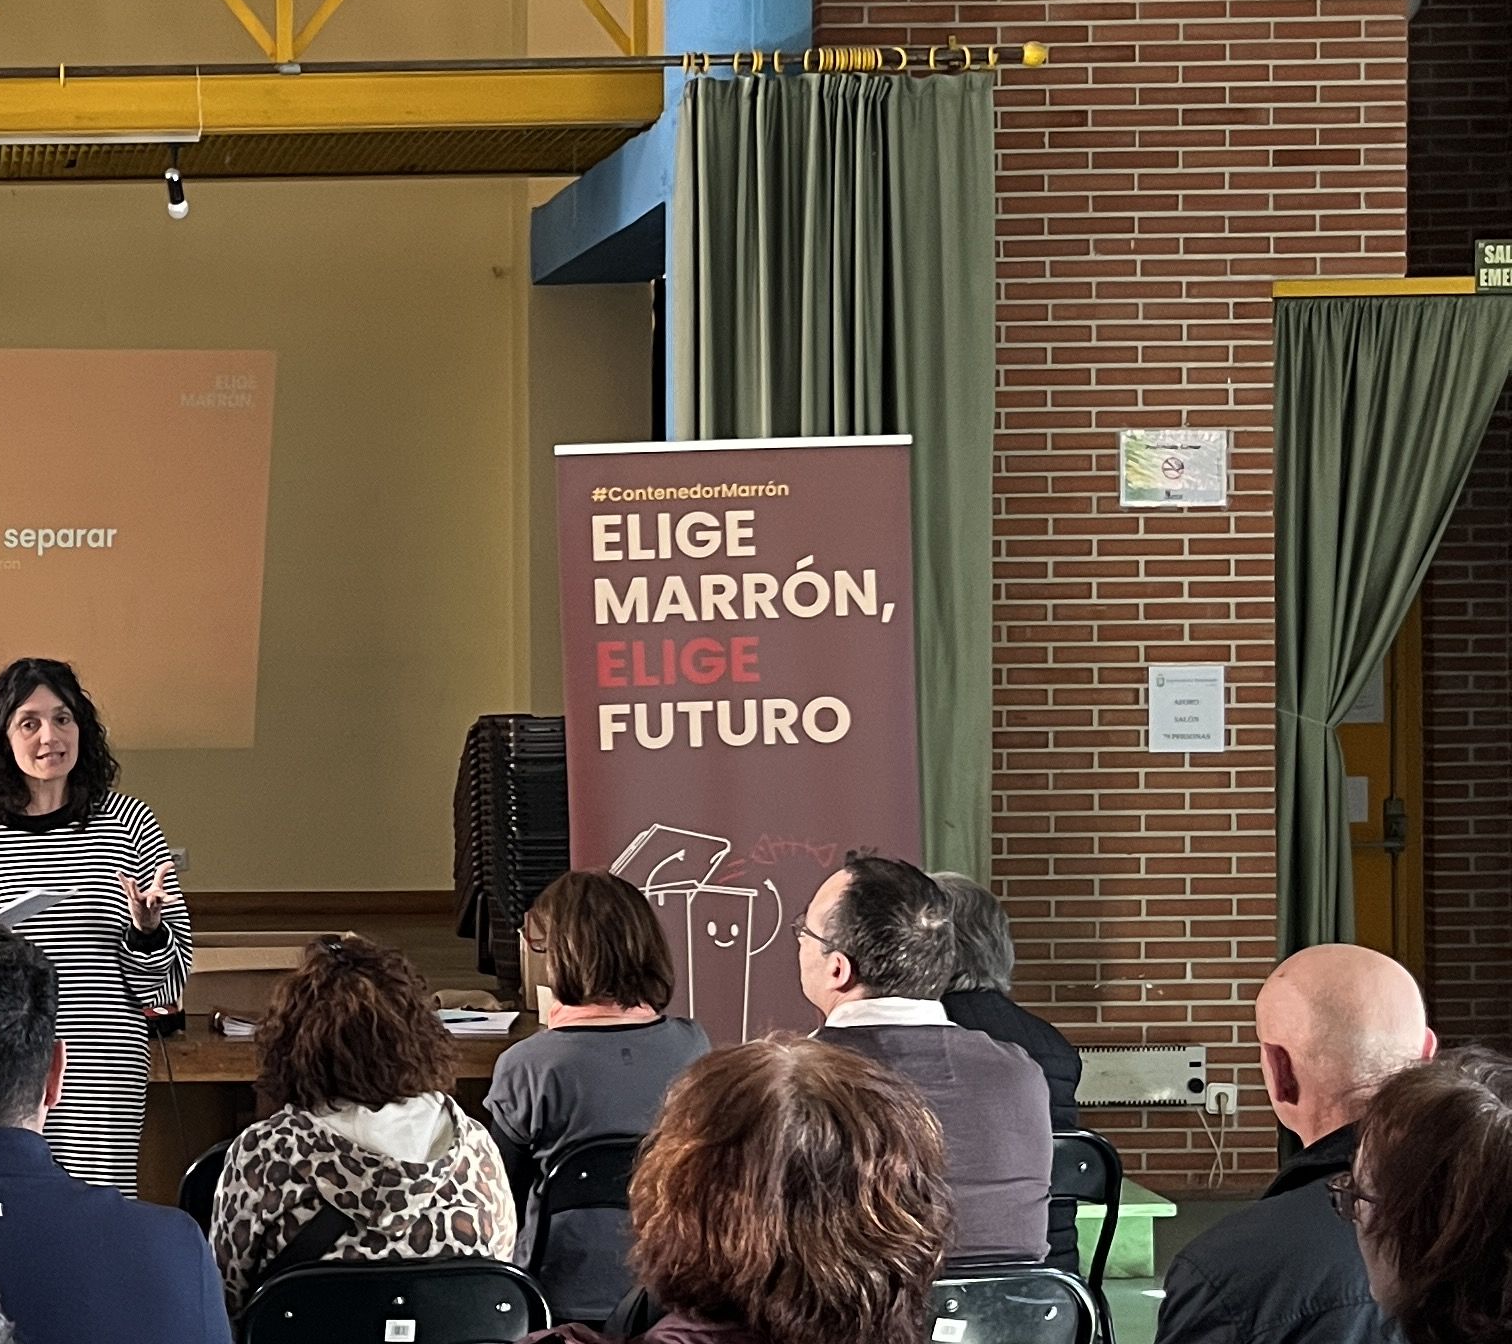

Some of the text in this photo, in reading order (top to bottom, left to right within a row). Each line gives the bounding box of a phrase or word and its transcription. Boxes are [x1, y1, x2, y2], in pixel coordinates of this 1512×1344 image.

[591, 481, 790, 503] #ContenedorMarrón
[4, 528, 118, 556] separar
[592, 510, 757, 562] ELIGE
[594, 555, 895, 625] MARRÓN,
[596, 636, 761, 688] ELIGE
[598, 696, 852, 751] FUTURO
